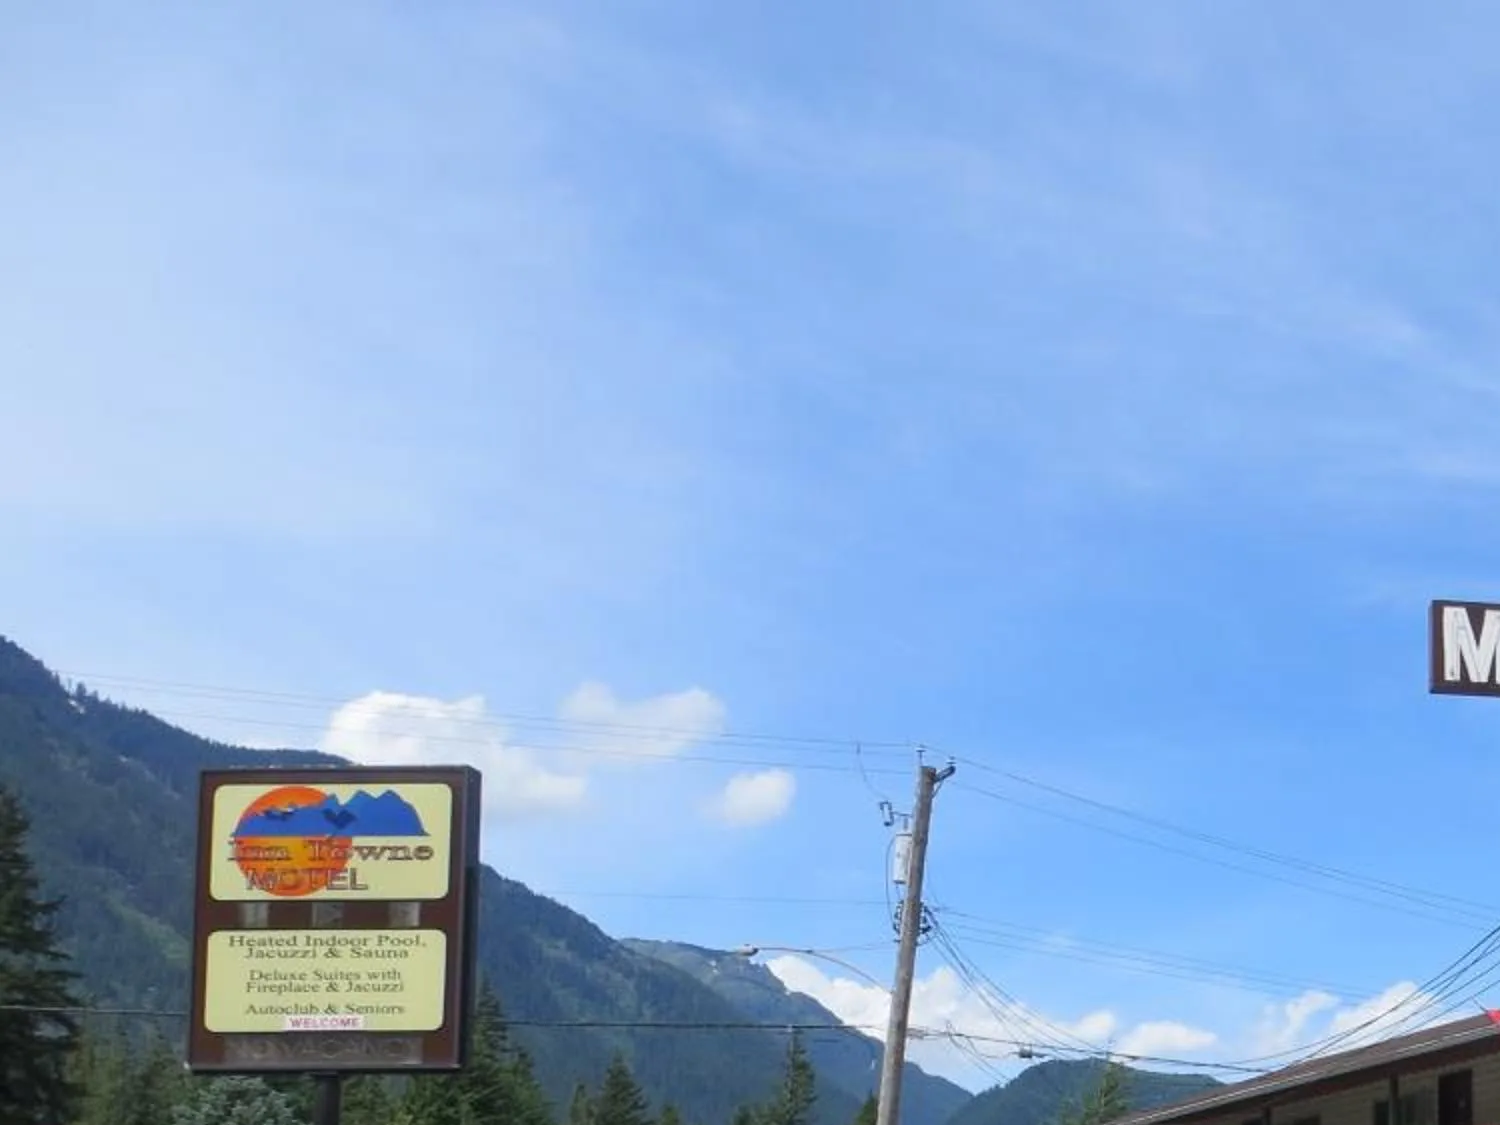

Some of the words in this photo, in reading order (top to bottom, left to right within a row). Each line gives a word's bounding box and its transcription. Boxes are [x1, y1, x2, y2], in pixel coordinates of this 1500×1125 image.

[246, 867, 369, 890] MOTEL
[228, 935, 297, 947] Heated
[304, 935, 369, 947] Indoor
[244, 948, 316, 959] Jacuzzi
[323, 948, 341, 959] &
[350, 948, 409, 959] Sauna
[249, 969, 307, 981] Deluxe
[312, 969, 360, 981] Suites
[367, 969, 401, 981] with
[245, 981, 320, 994] Fireplace
[325, 981, 339, 993] &
[345, 981, 404, 993] Jacuzzi
[245, 1003, 320, 1015] Autoclub
[324, 1003, 339, 1015] &
[344, 1003, 405, 1015] Seniors
[289, 1017, 361, 1028] WELCOME
